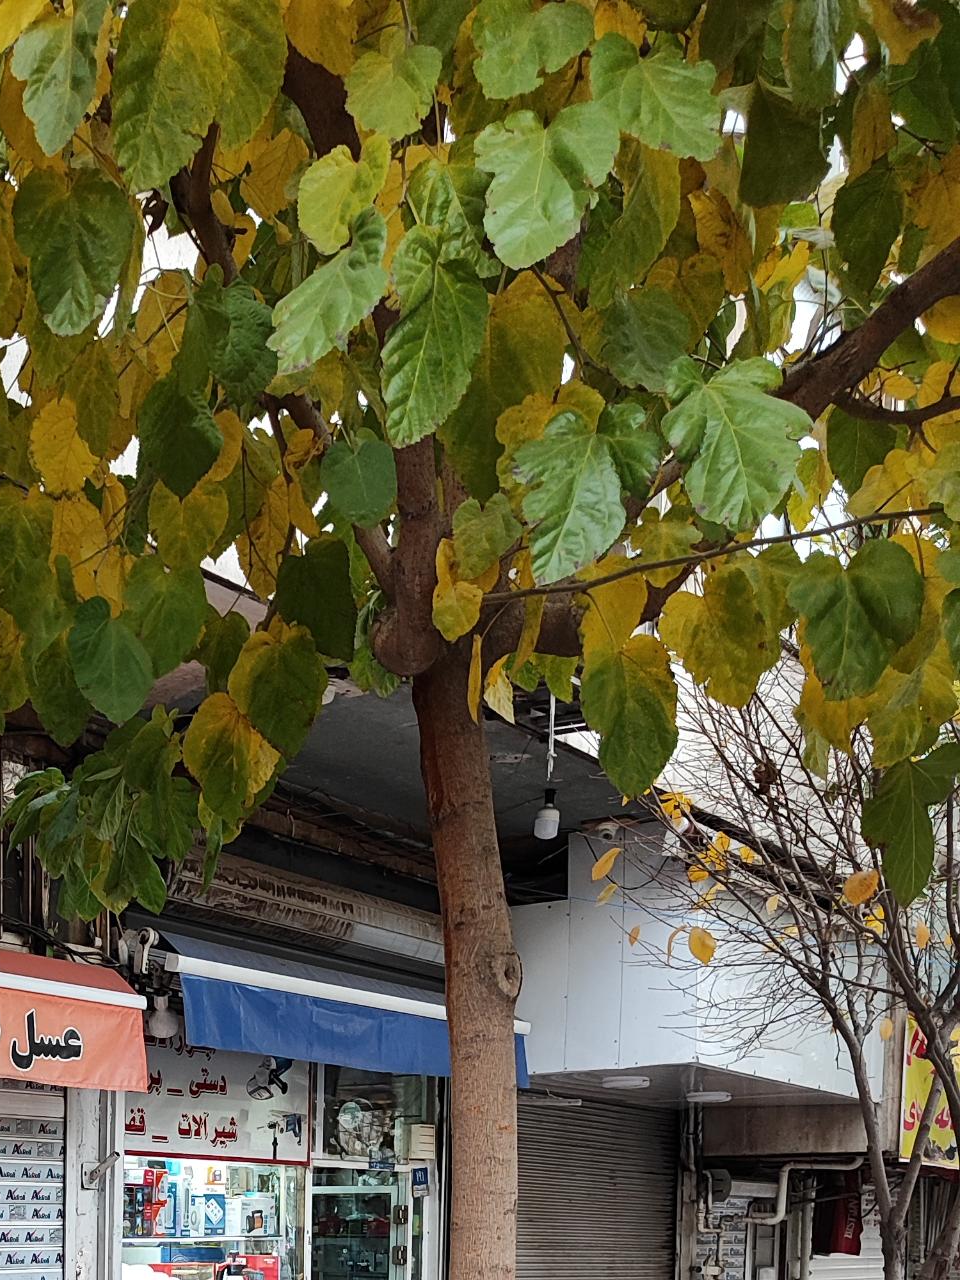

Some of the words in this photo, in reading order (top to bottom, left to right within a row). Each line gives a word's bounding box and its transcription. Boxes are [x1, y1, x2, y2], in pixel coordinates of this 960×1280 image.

[10, 1010, 83, 1070] عسل
[188, 1067, 228, 1098] دستی
[125, 1107, 146, 1135] قف
